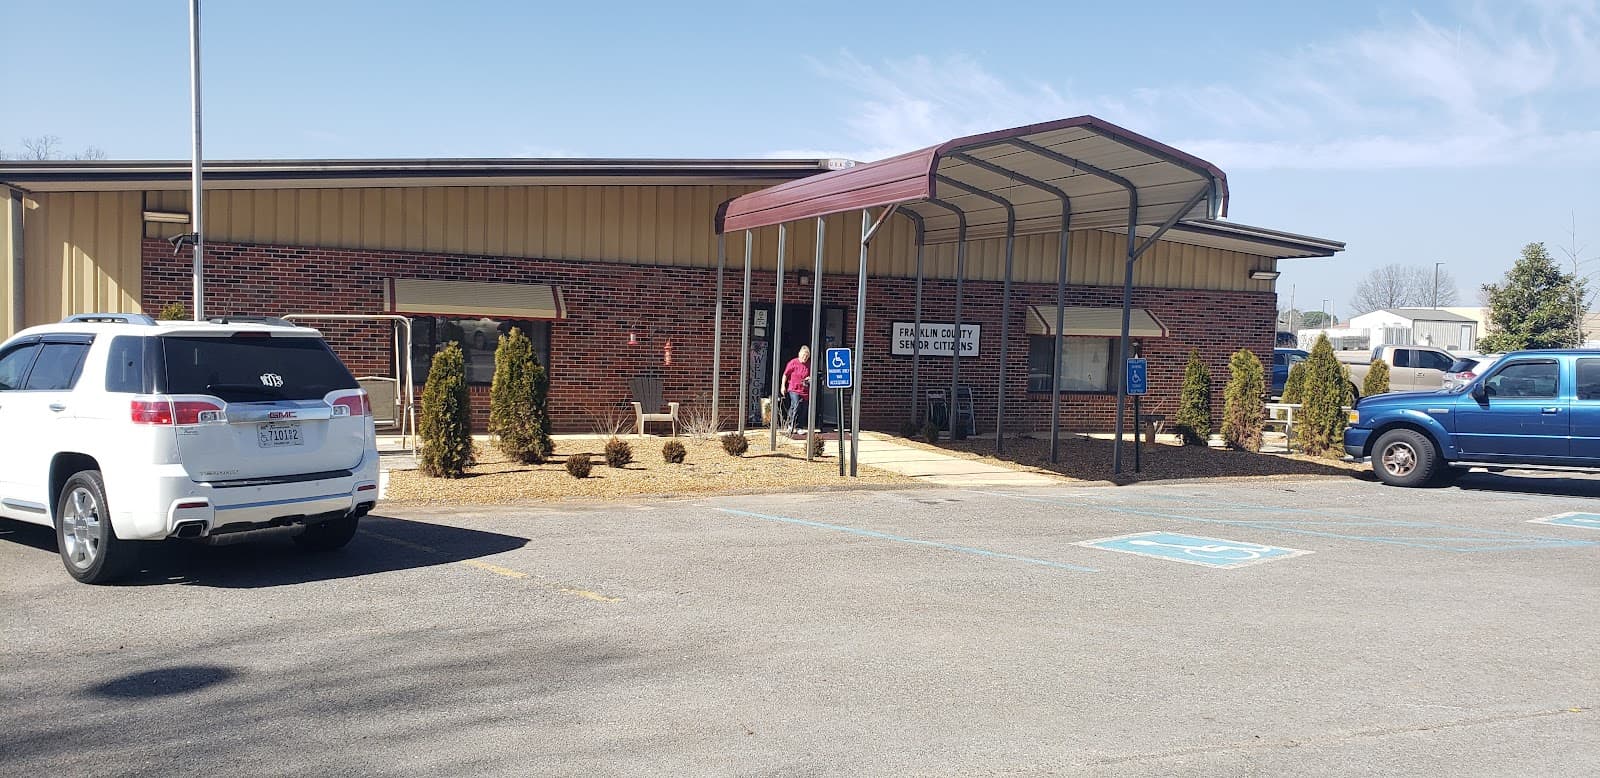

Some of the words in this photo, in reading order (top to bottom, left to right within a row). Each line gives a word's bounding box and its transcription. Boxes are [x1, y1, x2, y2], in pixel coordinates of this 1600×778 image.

[899, 328, 938, 338] FRAKLIN
[941, 329, 973, 339] COUTY
[899, 340, 929, 350] SENOR
[933, 341, 973, 351] CITIZNS
[268, 411, 298, 419] GMC
